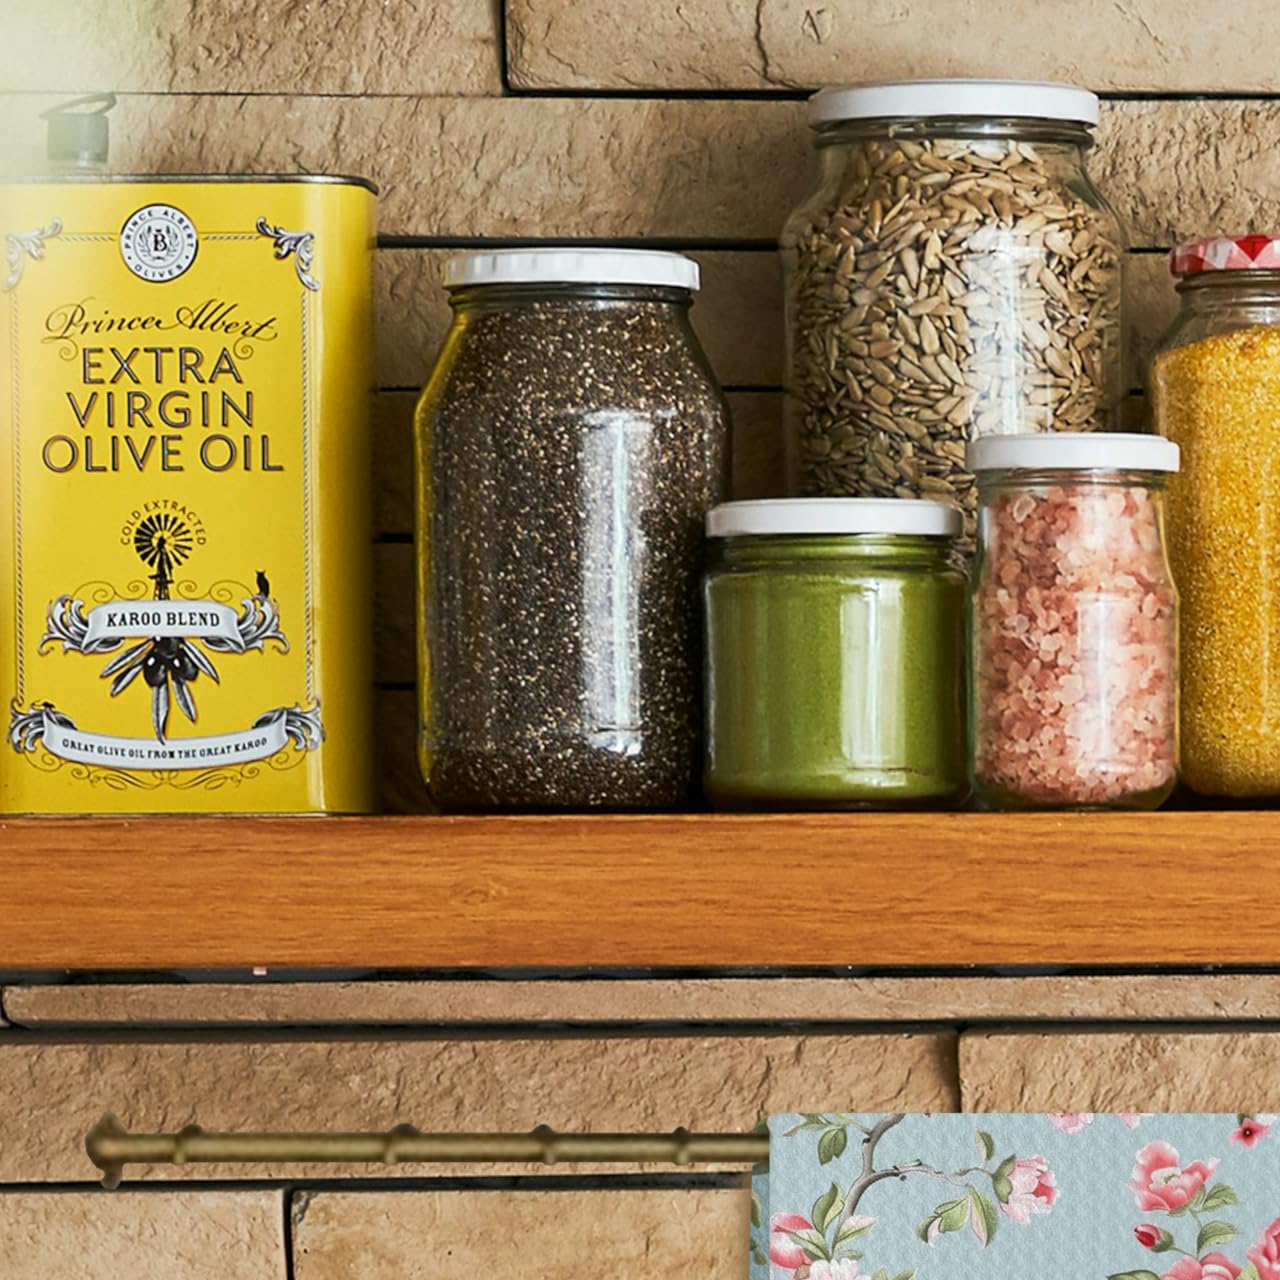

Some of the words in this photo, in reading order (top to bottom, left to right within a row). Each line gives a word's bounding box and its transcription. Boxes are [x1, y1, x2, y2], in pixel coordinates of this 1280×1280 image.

[124, 210, 153, 249] PRINCE
[162, 209, 194, 248] ALBERT
[134, 263, 183, 279] OLIVES
[42, 296, 163, 344] Prince
[174, 298, 278, 343] Albert
[82, 346, 243, 384] EXTRA
[66, 390, 254, 429] VIRGIN
[41, 434, 184, 473] OLIVE
[199, 433, 284, 472] OIL
[119, 510, 142, 546] COLD
[143, 499, 207, 546] EXTRACTED
[106, 611, 161, 628] KAROO
[165, 611, 220, 627] BLEND
[62, 738, 95, 753] GREAT
[97, 745, 126, 757] OLIVE
[128, 749, 145, 759] OIL
[147, 750, 176, 759] FROM
[178, 749, 197, 759] THE
[199, 744, 233, 757] GREAT
[234, 737, 268, 752] KAROO
